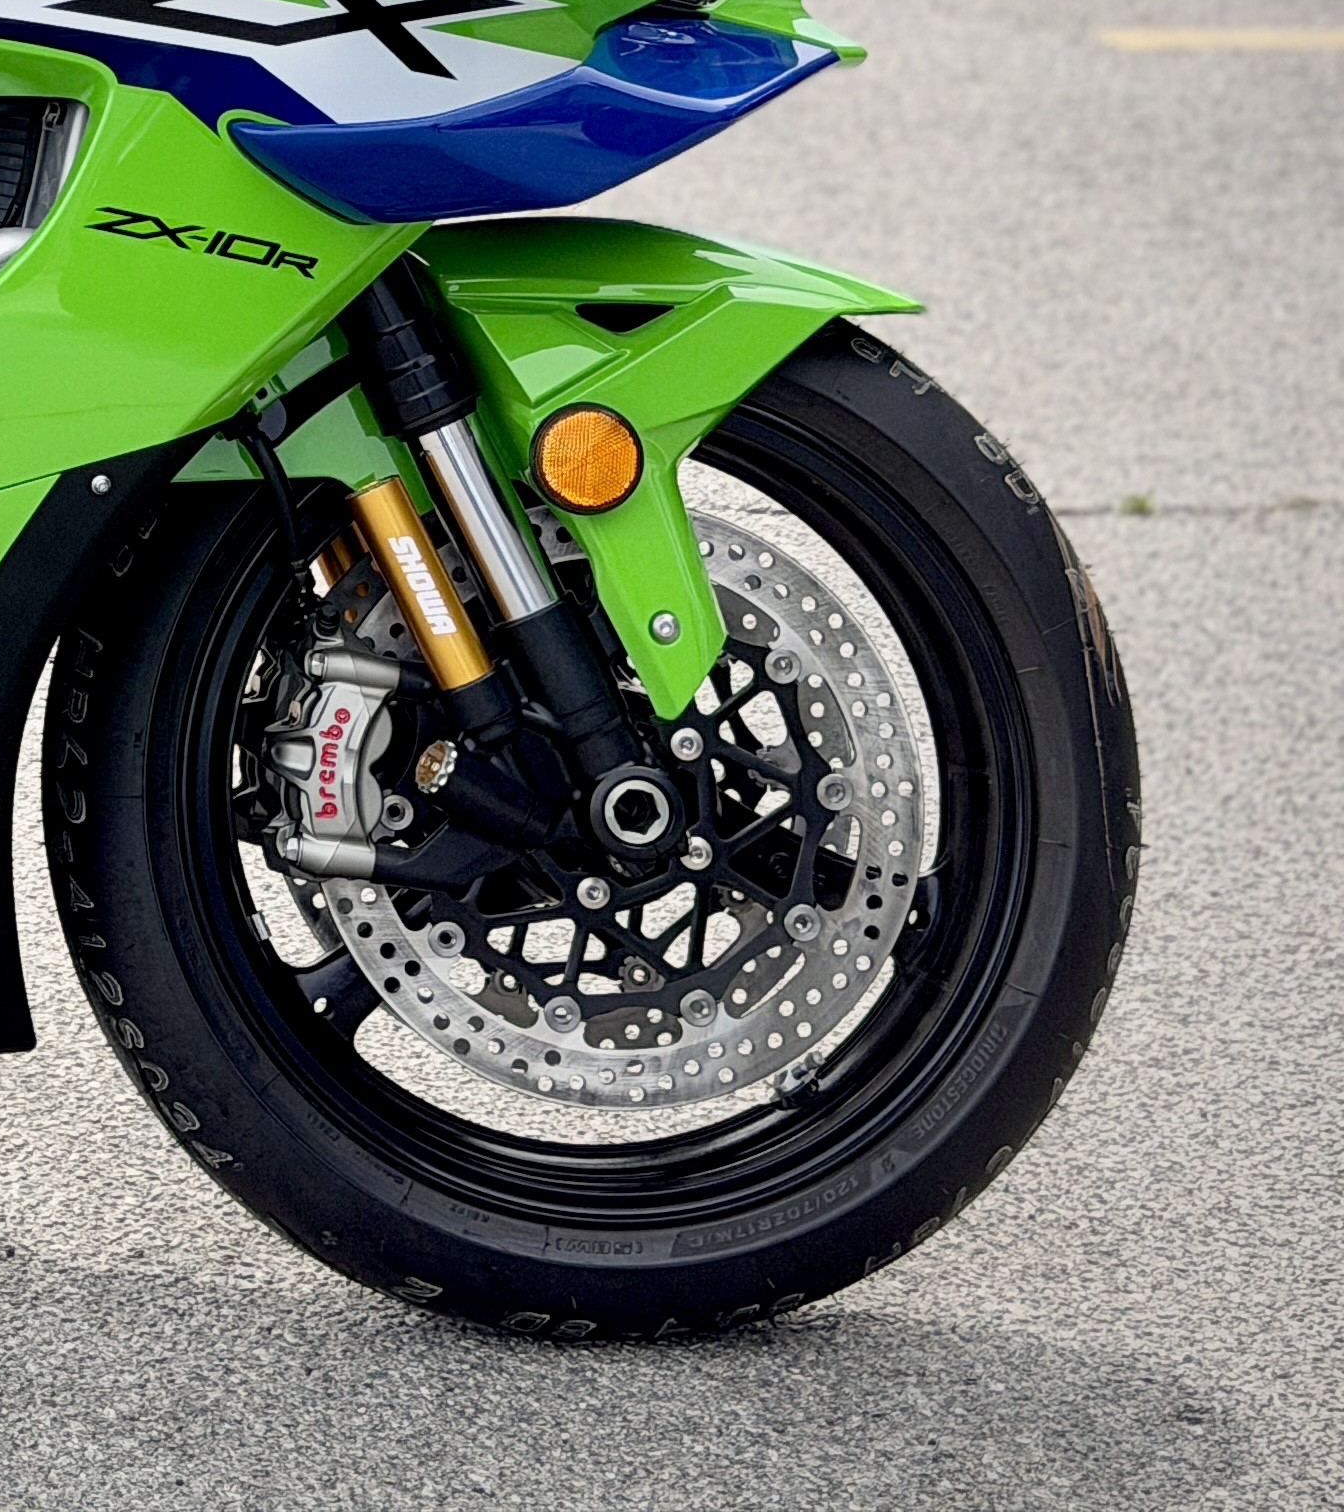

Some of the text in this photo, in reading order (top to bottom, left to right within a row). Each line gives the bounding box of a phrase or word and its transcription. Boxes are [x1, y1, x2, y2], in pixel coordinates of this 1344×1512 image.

[84, 207, 318, 279] ZX-10R
[387, 535, 457, 636] SHOWA
[314, 707, 352, 819] brembo
[907, 1019, 1010, 1143] BRIDGESTONE
